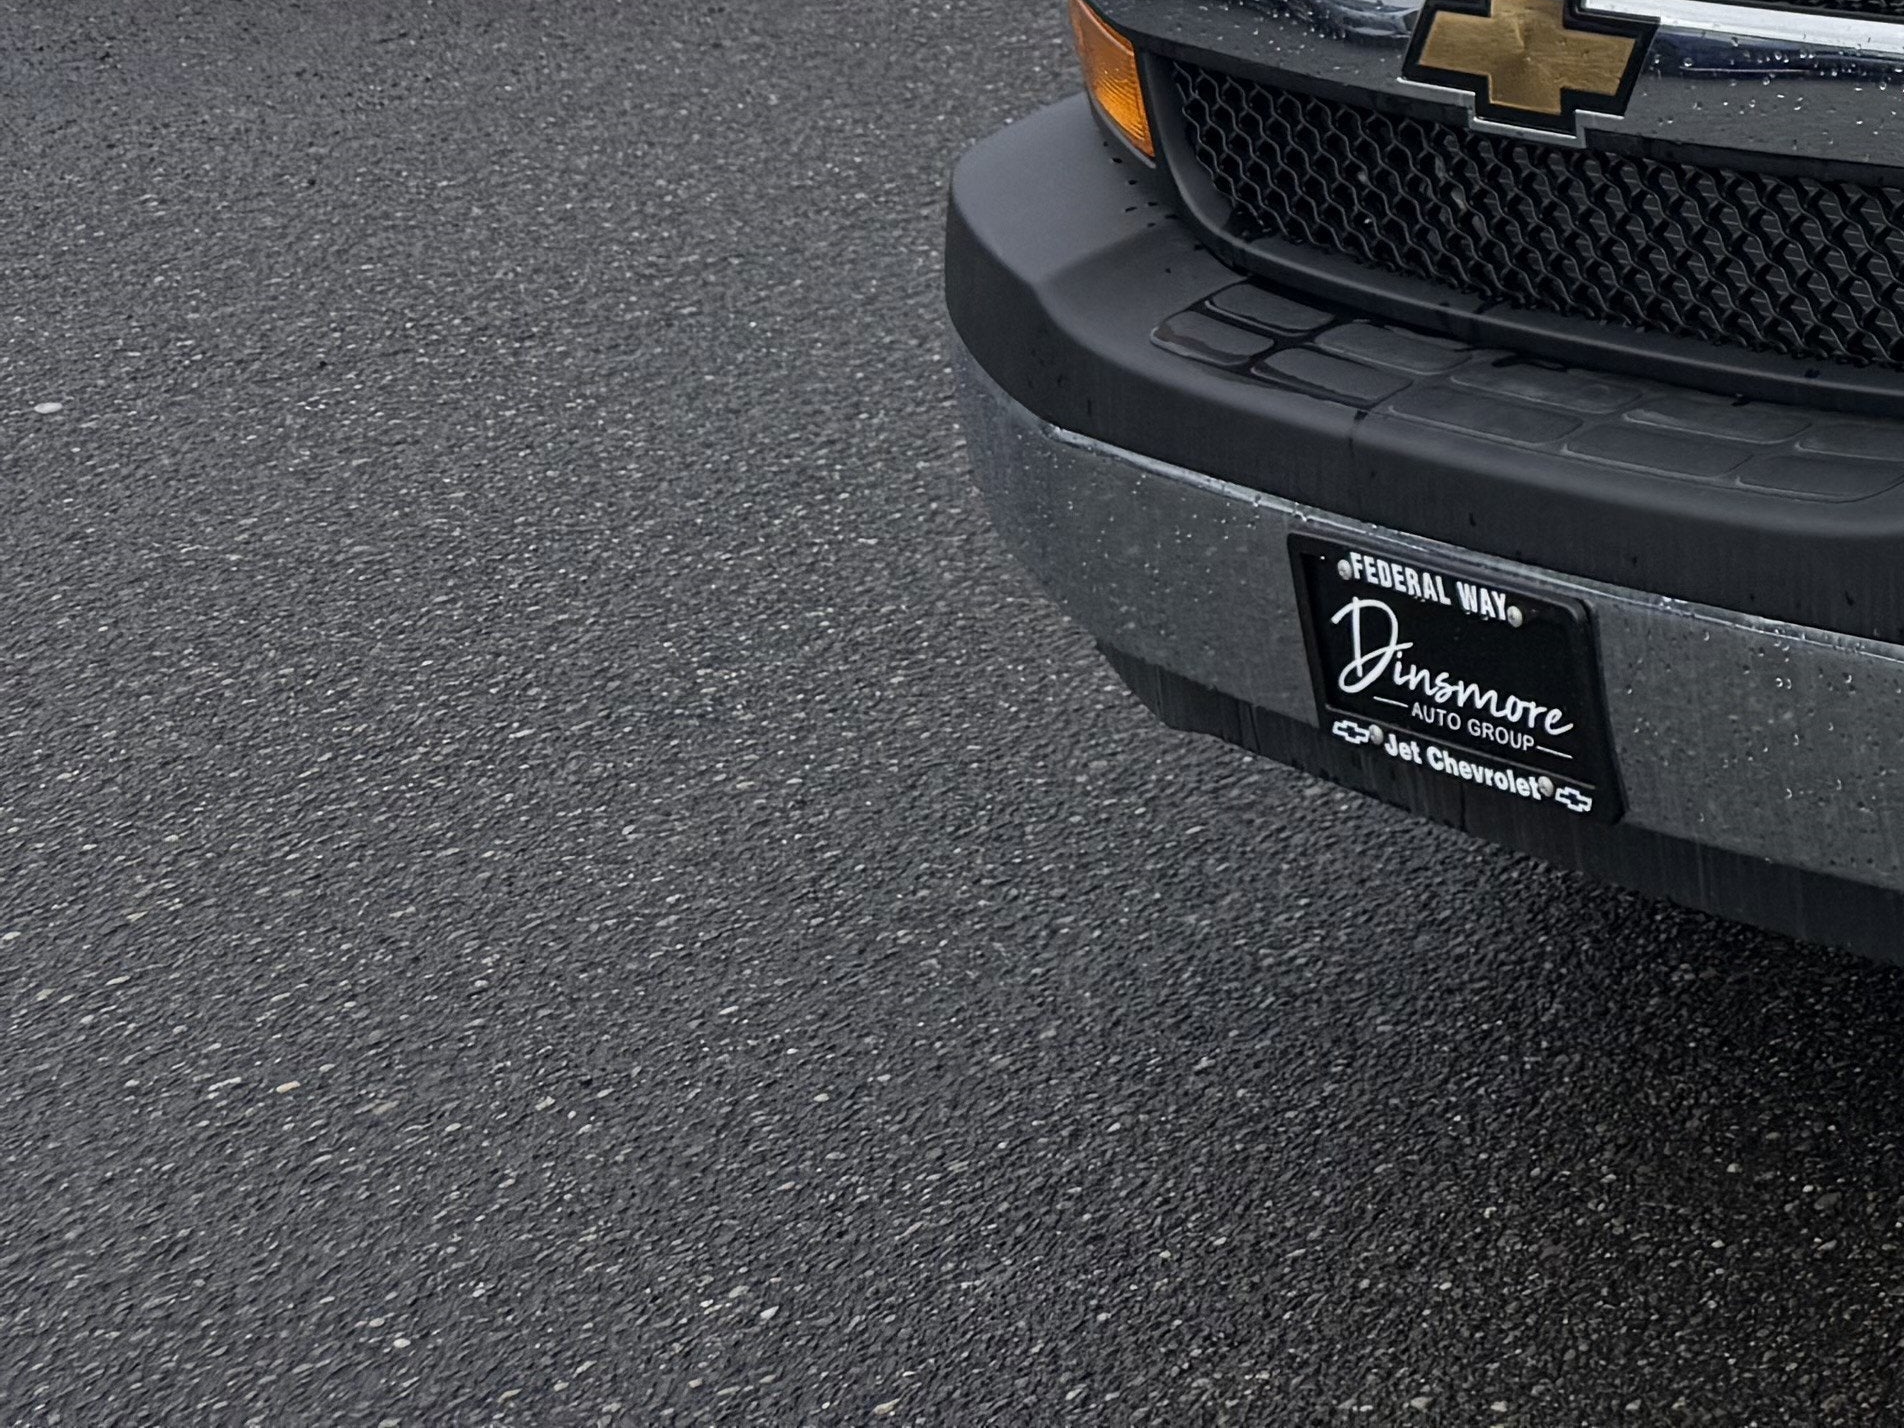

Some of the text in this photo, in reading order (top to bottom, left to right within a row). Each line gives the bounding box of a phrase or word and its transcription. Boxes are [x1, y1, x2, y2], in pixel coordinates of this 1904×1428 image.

[1350, 552, 1507, 621] FEDERAL WAY
[1330, 597, 1574, 735] Dinsmore
[1411, 702, 1535, 751] AUTO GROUP
[1384, 733, 1542, 800] Jet Chevrolet
